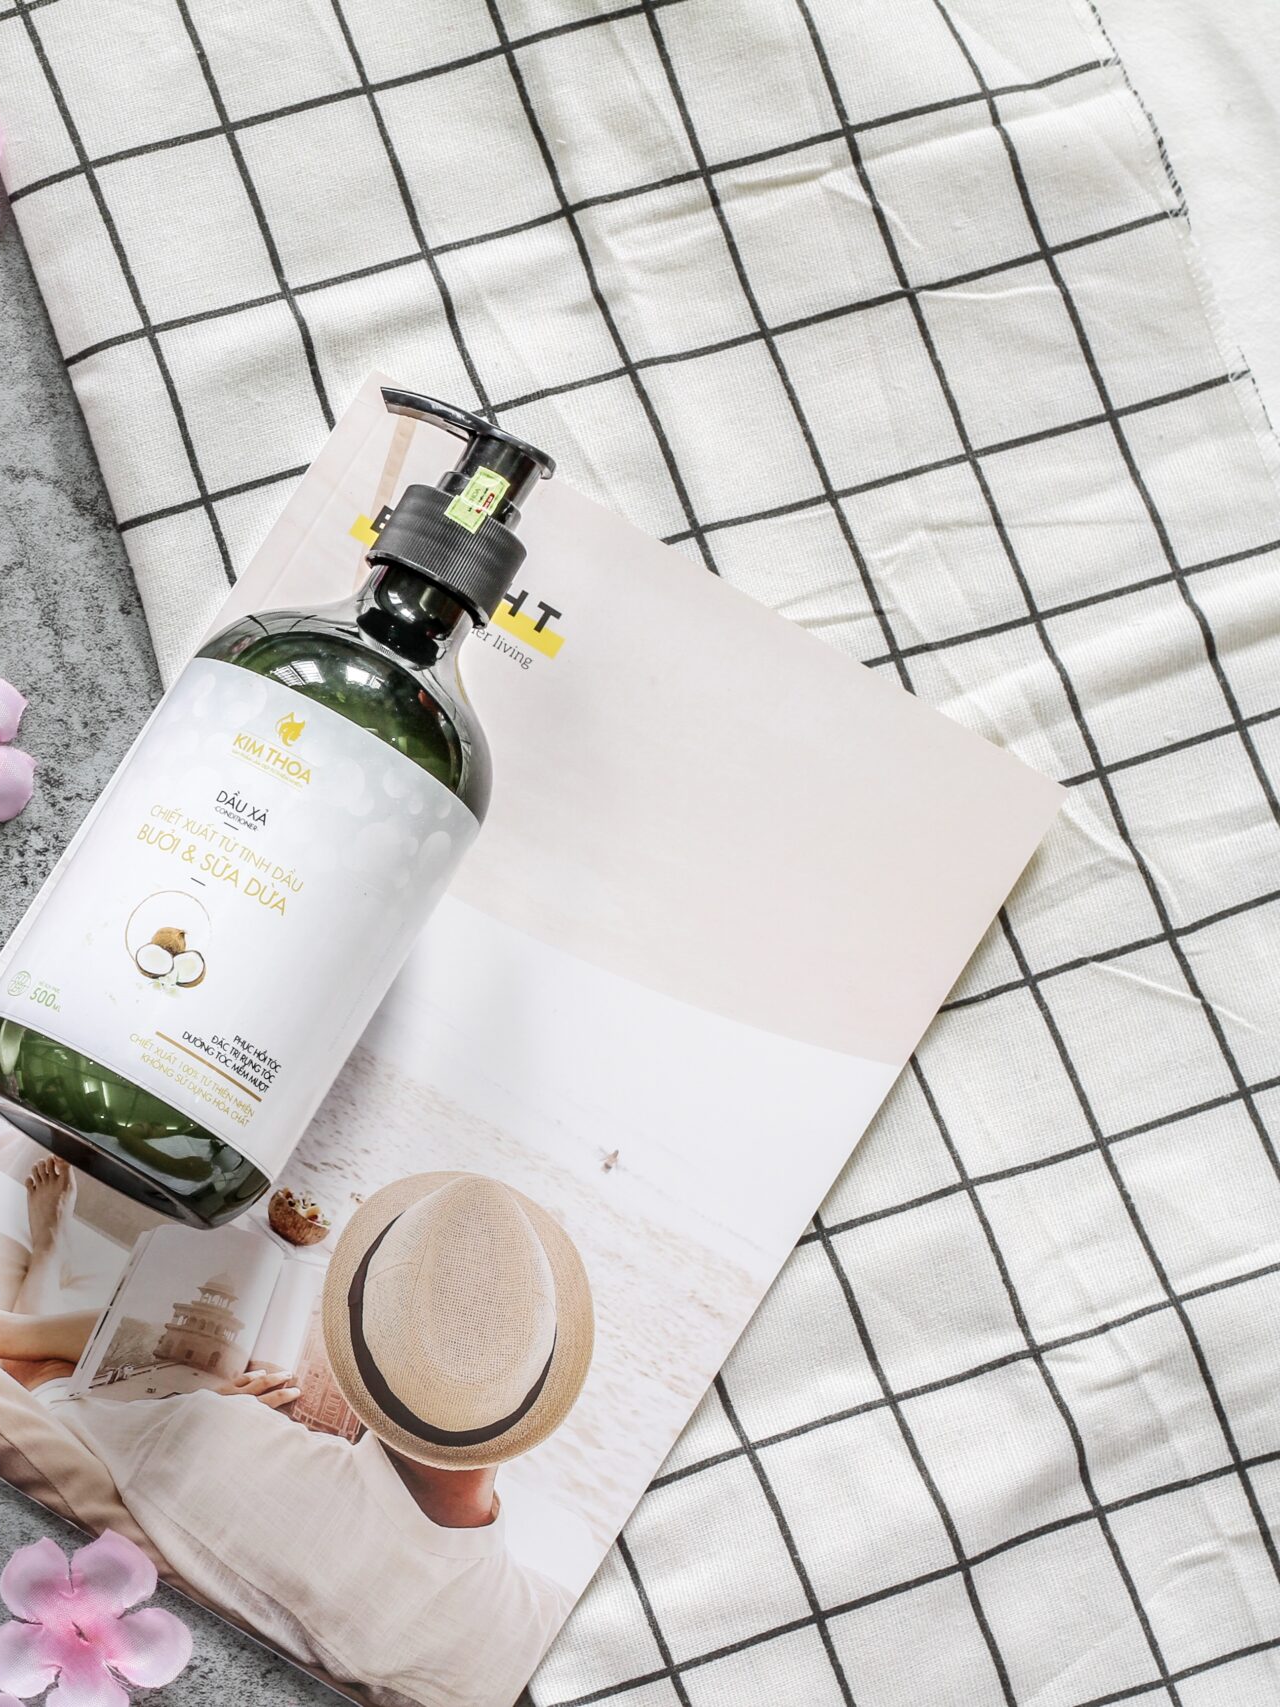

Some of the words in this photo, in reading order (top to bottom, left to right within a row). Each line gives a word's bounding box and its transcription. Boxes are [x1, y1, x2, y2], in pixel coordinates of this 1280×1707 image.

[493, 634, 533, 670] living
[233, 733, 265, 757] KIM
[265, 747, 312, 784] THOA
[216, 790, 248, 813] DẦU
[247, 808, 269, 826] XẢ
[136, 823, 181, 854] BƯỞI
[181, 844, 197, 863] &
[200, 853, 240, 888] SỮA
[244, 877, 286, 916] DỪA
[150, 804, 184, 825] CHIẾT
[183, 818, 218, 843] XUẤT
[238, 846, 271, 873] TINH
[271, 866, 304, 893] DẦU
[140, 1053, 175, 1078] KHÔNG
[187, 1081, 213, 1103] DỤNG
[182, 1031, 215, 1056] DƯỠNG
[215, 1051, 232, 1068] TÓC
[249, 1075, 270, 1094] MƯỢT
[211, 1035, 230, 1051] ĐẶC
[230, 1045, 241, 1059] TRỊ
[240, 1054, 261, 1073] RỤNG
[261, 1067, 276, 1084] TÓC
[233, 1035, 253, 1054] PHỤC
[268, 1058, 282, 1073] TÓC
